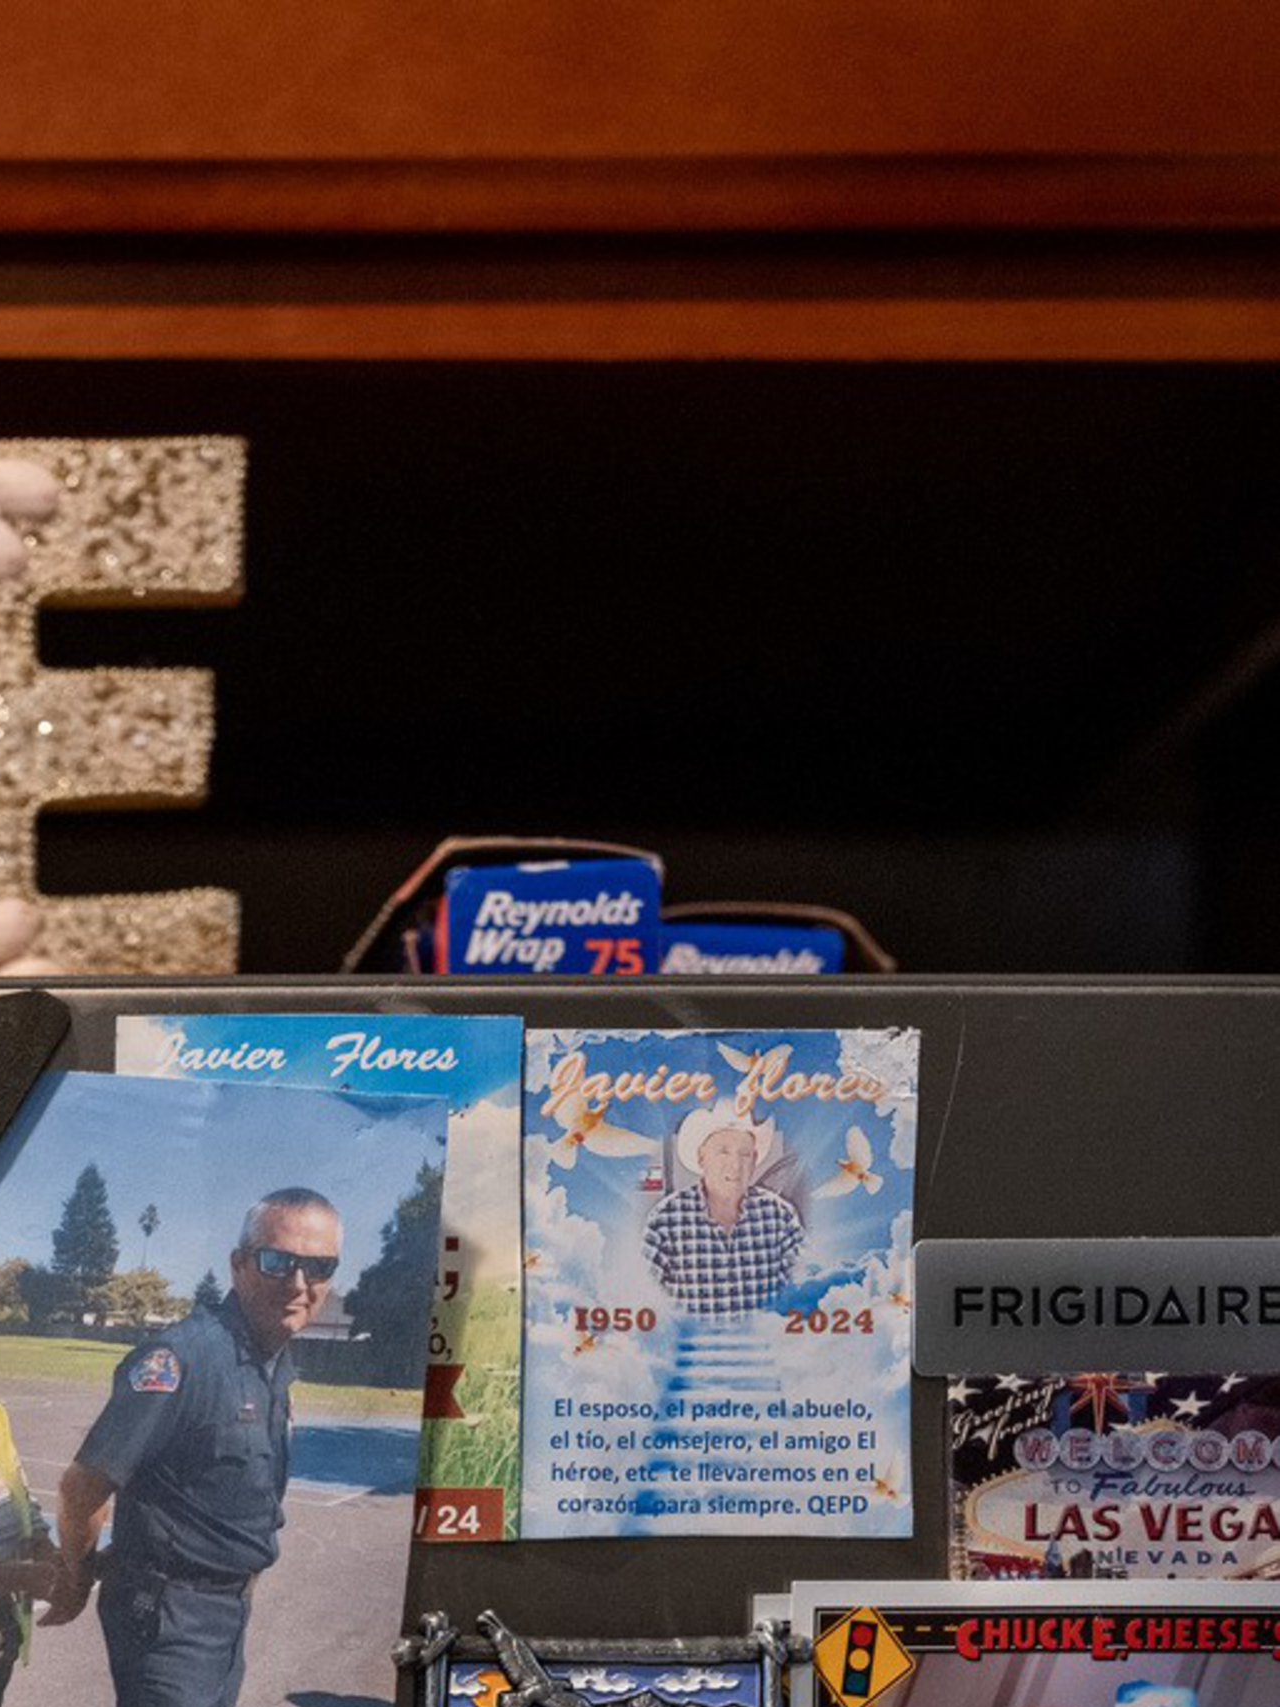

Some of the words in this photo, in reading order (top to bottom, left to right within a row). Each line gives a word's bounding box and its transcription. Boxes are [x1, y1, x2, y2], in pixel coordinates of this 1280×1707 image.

[476, 891, 644, 929] Reynolds
[465, 930, 565, 970] Wrap
[585, 939, 644, 974] 75
[574, 1306, 656, 1334] 1950
[783, 1307, 874, 1335] 2024
[954, 1285, 1280, 1327] FRIGIDAIRE
[554, 1400, 572, 1419] El
[577, 1403, 658, 1423] esposo,
[665, 1399, 685, 1419] el
[691, 1400, 760, 1424] padre,
[767, 1400, 787, 1419] el
[792, 1400, 873, 1423] abuelo,
[951, 1374, 1067, 1449] Greetings
[550, 1430, 570, 1451] el
[575, 1430, 612, 1455] tío,
[617, 1431, 636, 1451] el
[642, 1431, 752, 1458] consejero,
[759, 1431, 779, 1451] el
[783, 1432, 850, 1458] amigo
[856, 1432, 876, 1450] El
[983, 1411, 1053, 1461] from
[550, 1460, 619, 1487] héroe,
[625, 1463, 659, 1483] etc
[669, 1464, 691, 1483] te
[697, 1461, 815, 1482] llevaremos
[821, 1466, 849, 1483] en
[855, 1462, 876, 1482] el
[1050, 1479, 1081, 1495] TO
[1090, 1471, 1256, 1500] Fabulous
[557, 1493, 636, 1515] corazón
[653, 1497, 702, 1522] para
[706, 1495, 801, 1522] siempre.
[807, 1496, 867, 1518] QEPD
[1024, 1503, 1121, 1541] LAS
[1096, 1549, 1238, 1565] NEVADA
[956, 1618, 1092, 1661] CHUCK
[1092, 1616, 1130, 1661] E.
